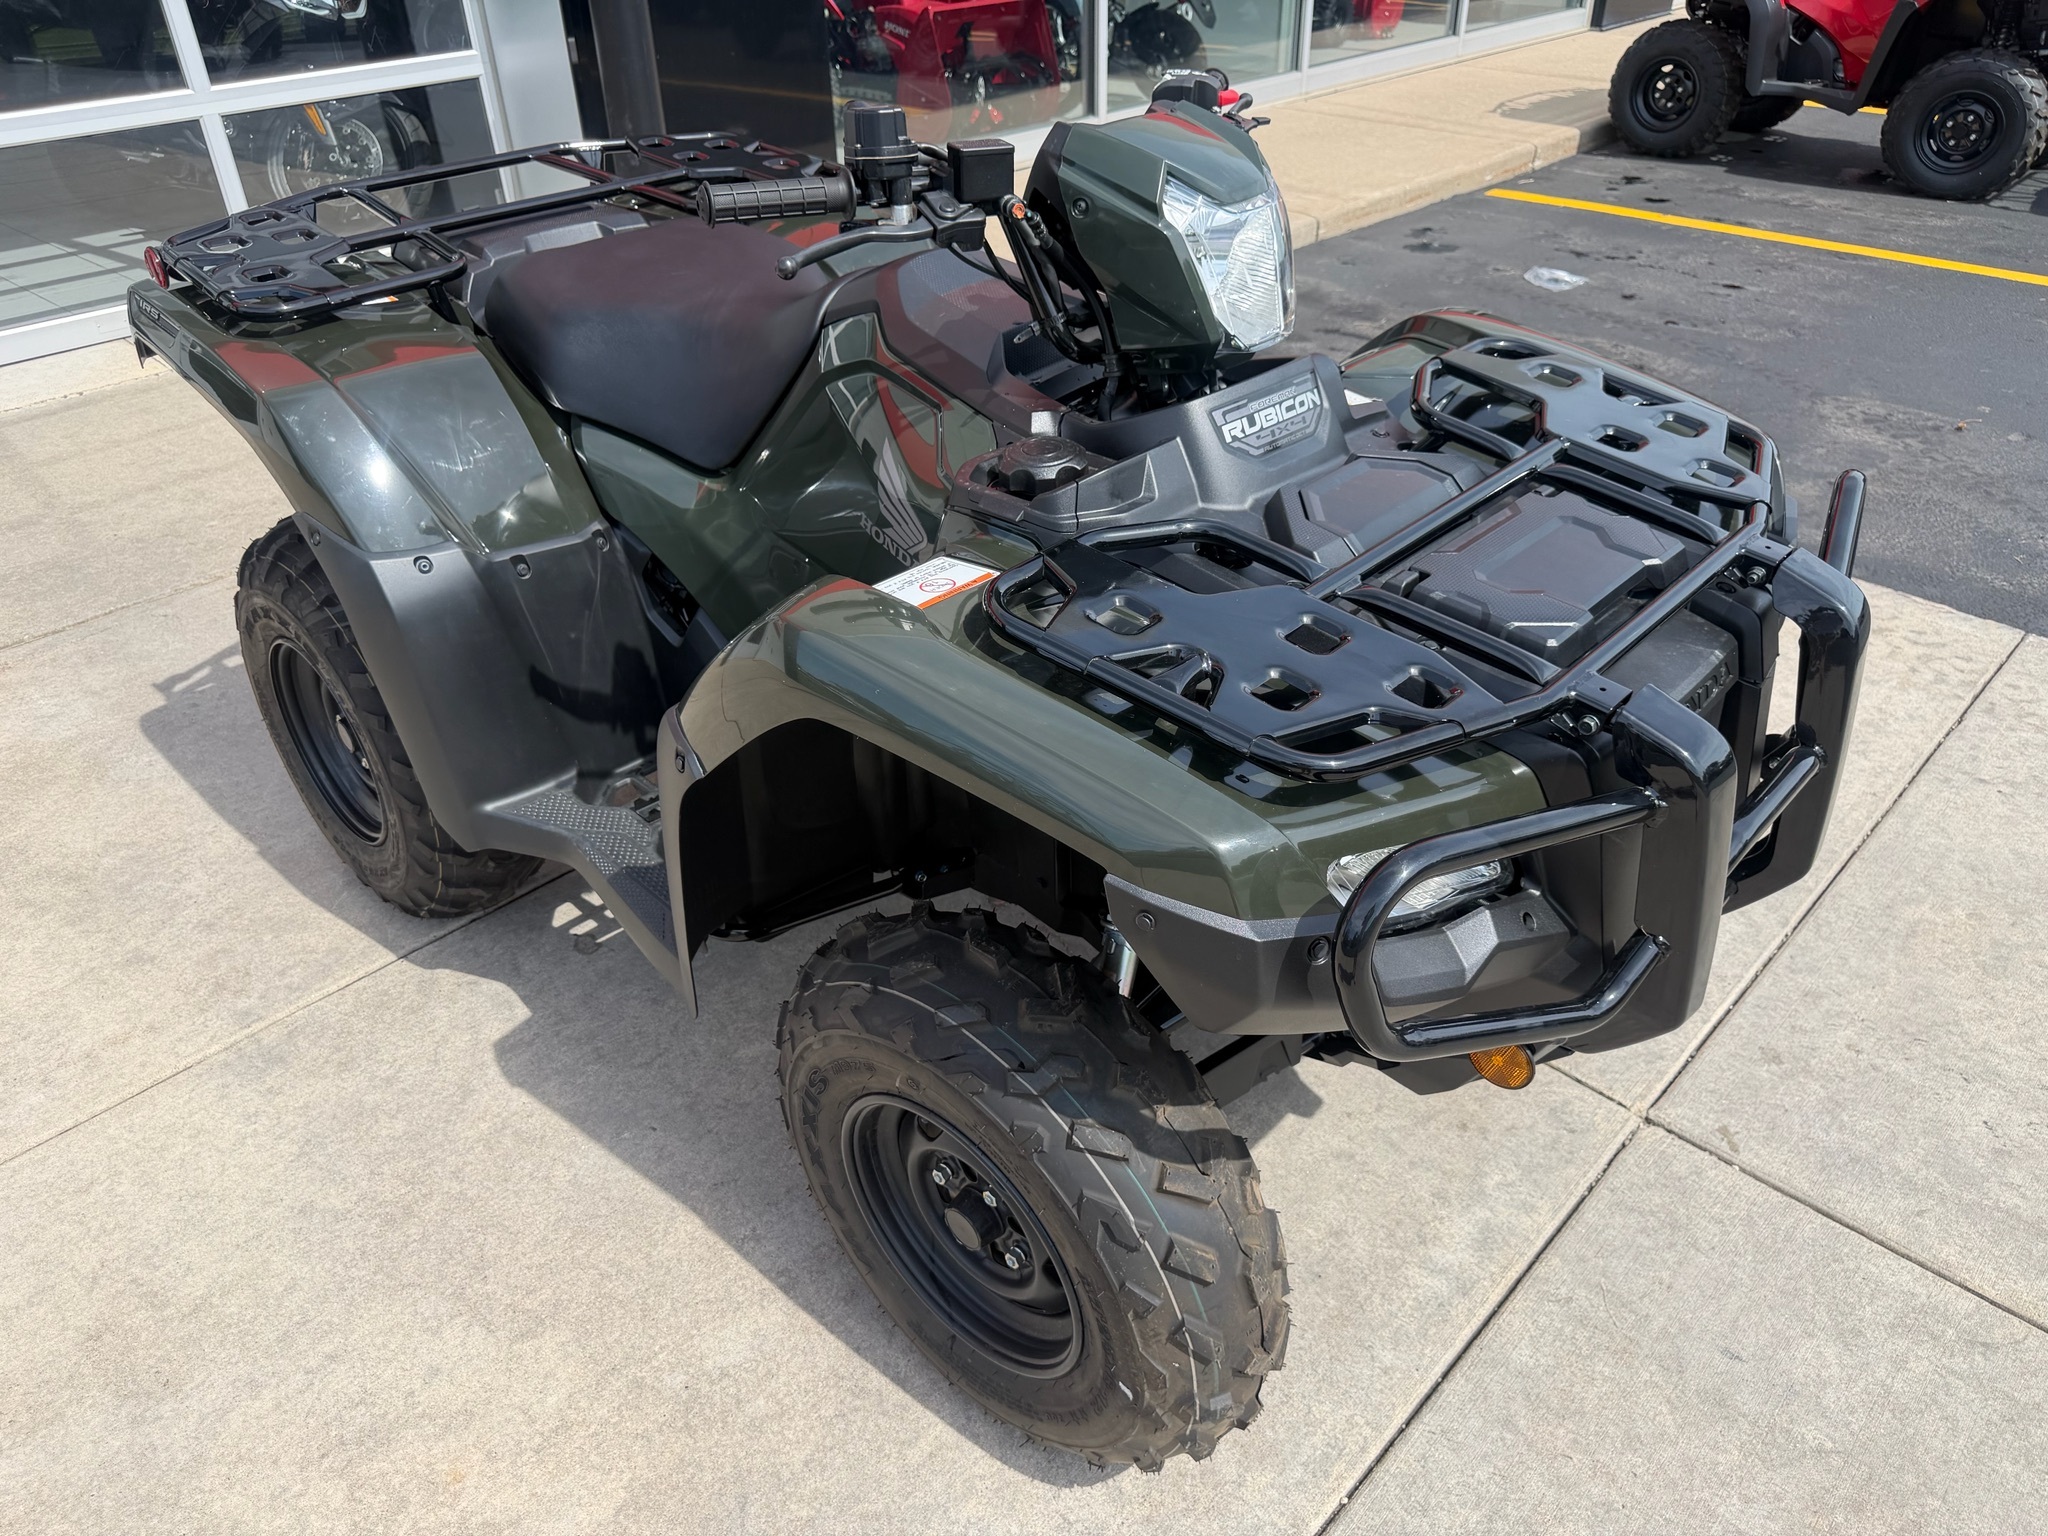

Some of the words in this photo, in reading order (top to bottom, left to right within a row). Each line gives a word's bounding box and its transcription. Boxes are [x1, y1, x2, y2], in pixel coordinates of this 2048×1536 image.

[140, 299, 159, 320] IRS
[1249, 387, 1297, 411] FOREMAN
[1221, 388, 1321, 444] RUBICON
